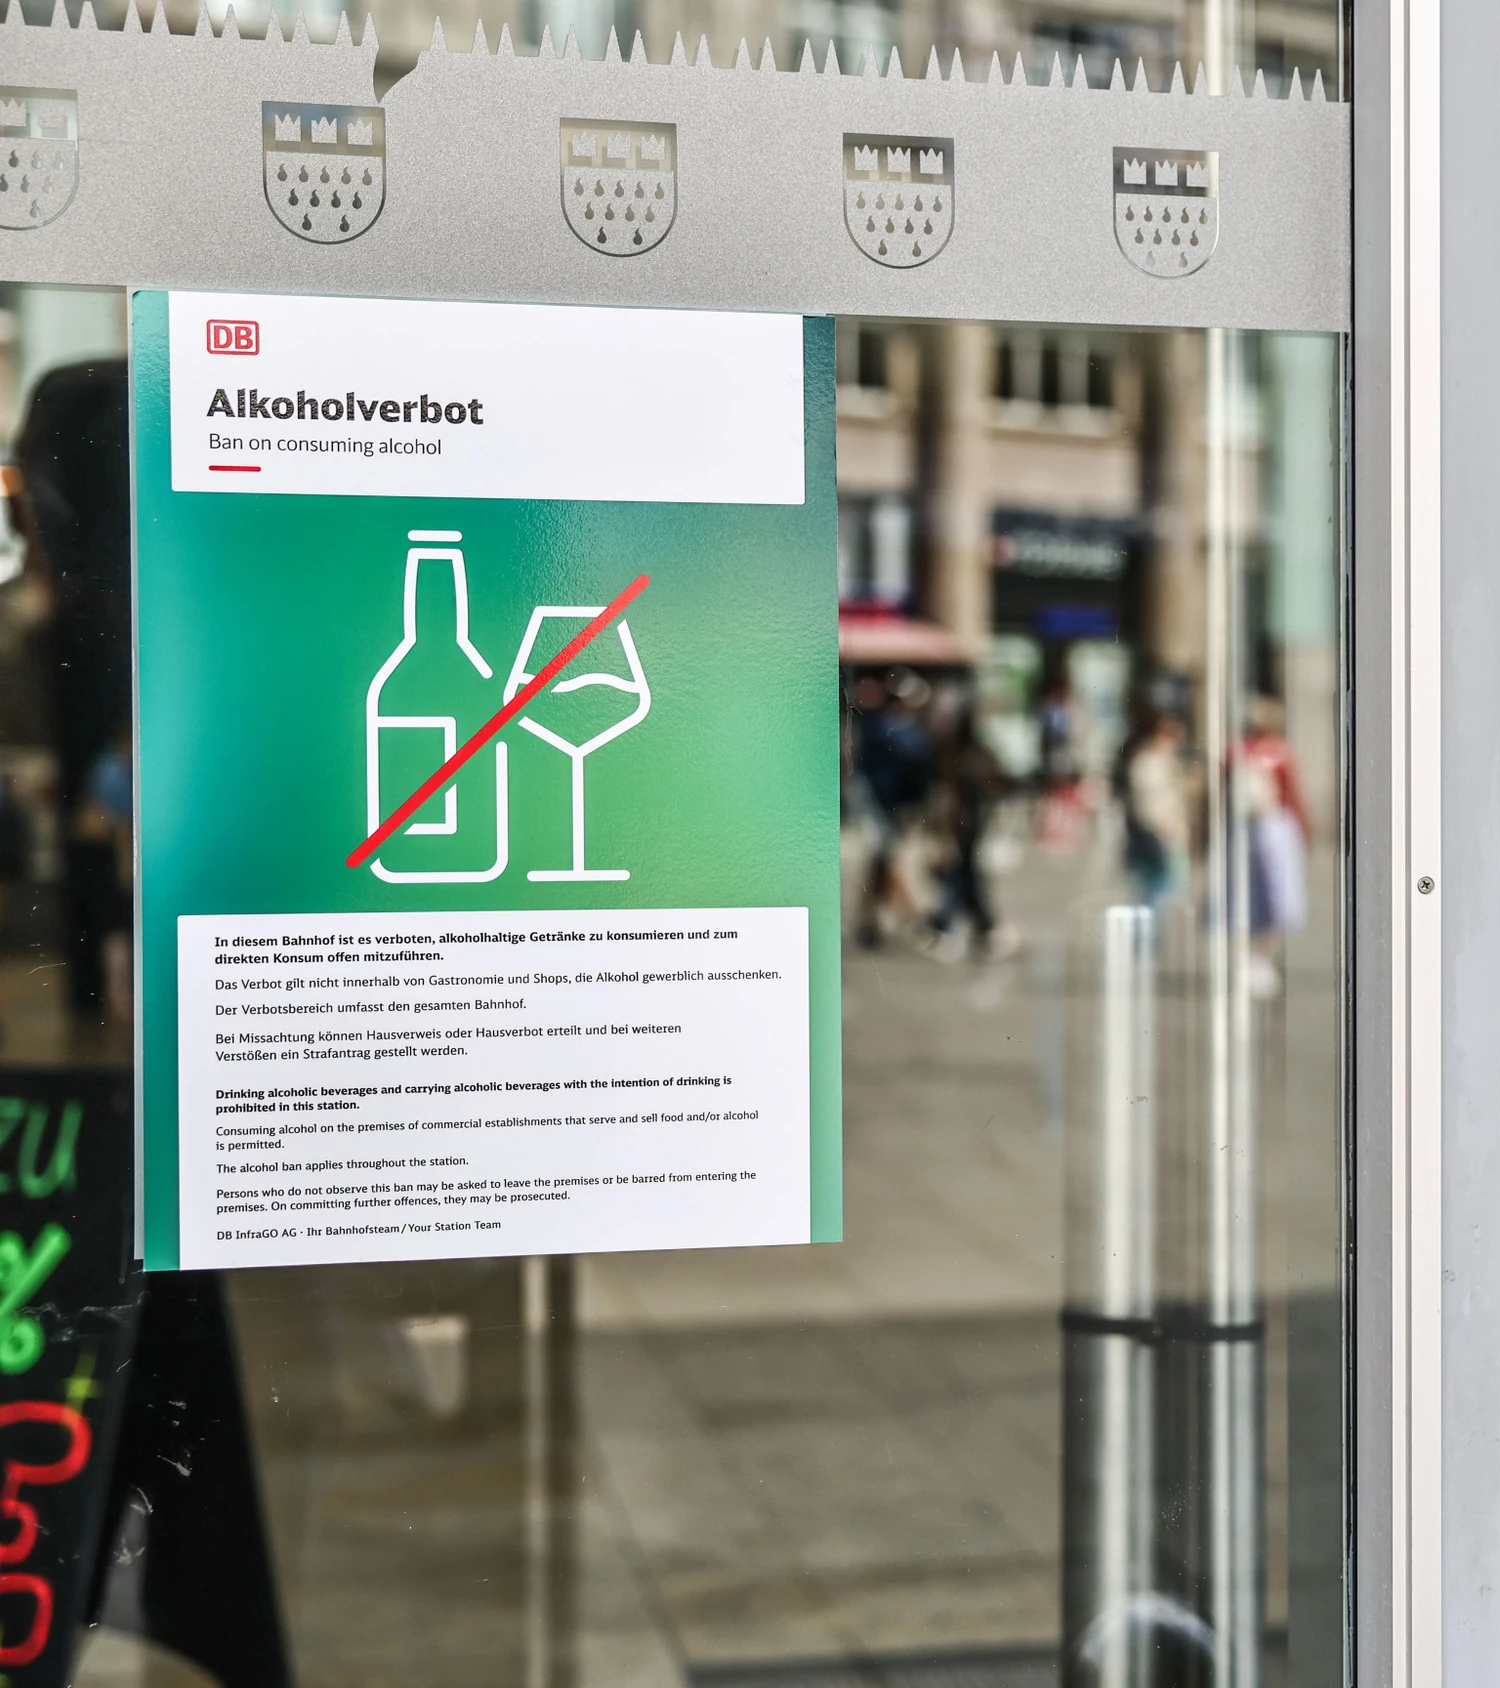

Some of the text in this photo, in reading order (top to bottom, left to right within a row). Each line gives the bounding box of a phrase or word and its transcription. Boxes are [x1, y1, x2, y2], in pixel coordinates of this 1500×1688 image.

[211, 323, 256, 351] DB
[206, 388, 484, 425] Alkoholverbot
[209, 433, 442, 457] Ban on consuming alcohol
[214, 929, 738, 948] In diesem Bahnhof ist es verboten, alkoholhaltige Getränke zu konsumieren und zum
[214, 950, 444, 965] direkten Konsum offen mitzuführen.
[215, 969, 782, 992] Das Verbot gilt nicht innerhalb von Gastronomie und Shops, die Alkohol gewerblich ausschenken.
[215, 998, 527, 1016] Der Verbotsbereich umfasst den gesamten Bahnhof.
[215, 1023, 682, 1045] Bei Missachtung können Hausverweis oder Hausverbot erteilt und bei weiteren
[215, 1044, 468, 1062] Verstößen ein Strafantrag gestellt werden.
[215, 1075, 732, 1101] Drinking alcoholic beverages and carrying alcoholic beverages with the intention of drinking is
[215, 1099, 360, 1116] prohibited in this station.
[215, 1110, 759, 1137] Consuming alcohol on the premises of commercial establishments that serve and sell food and/or alcohol
[215, 1138, 285, 1153] is permitted.
[216, 1155, 469, 1174] The alcohol ban applies throughout the station.
[216, 1170, 757, 1199] Persons who do not observe this ban may be asked to leave the premises or be barred from entering the
[216, 1190, 571, 1216] premises. On committing further offences, they may be prosecuted.
[216, 1220, 501, 1241] DB InfraGO AG Ihr Bahnhofsteam/Your Station Team
